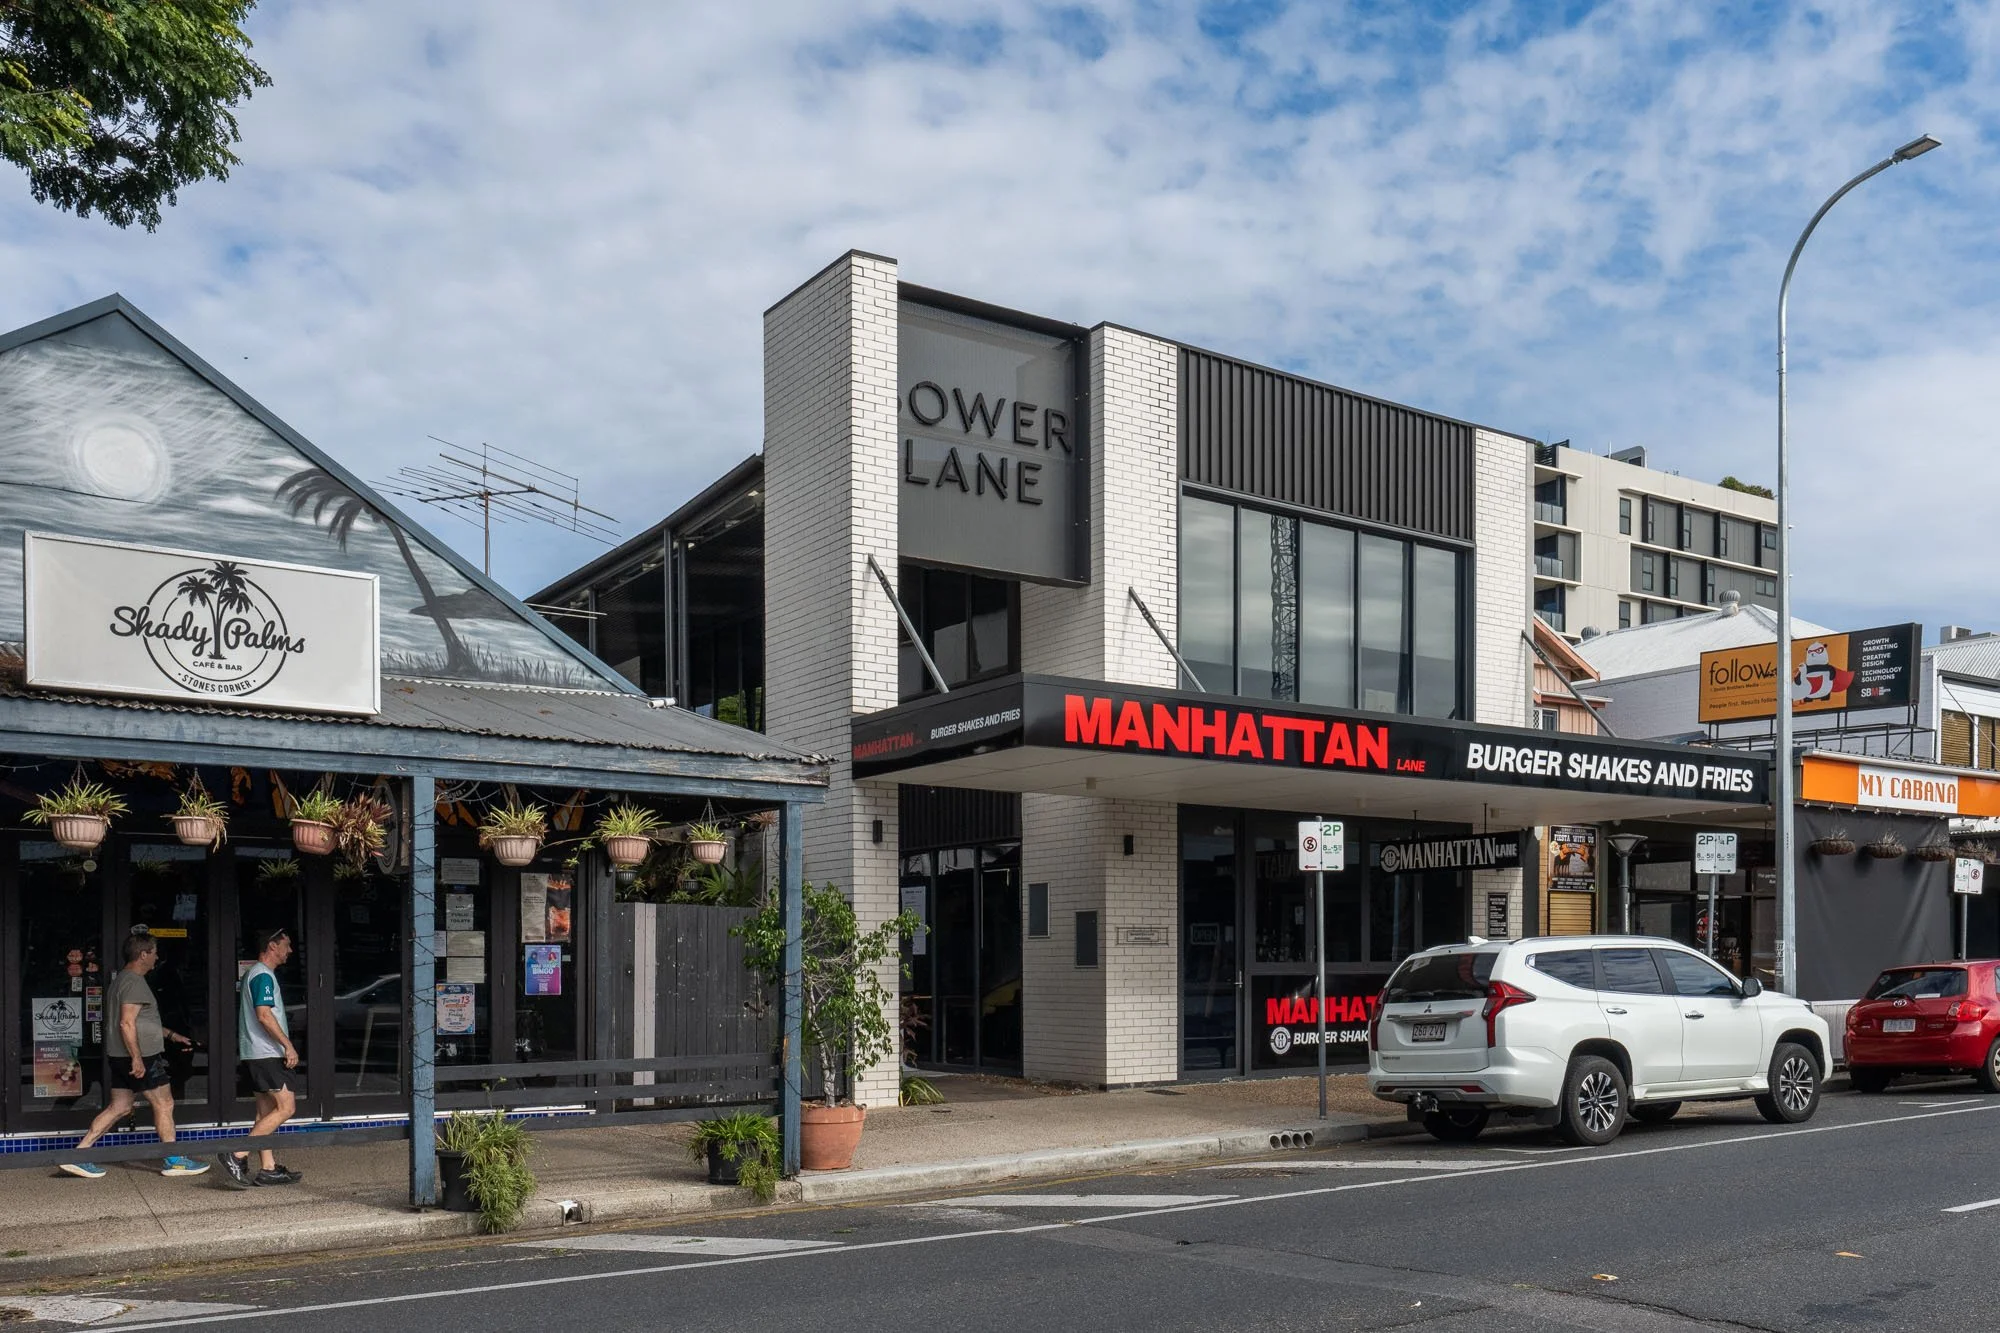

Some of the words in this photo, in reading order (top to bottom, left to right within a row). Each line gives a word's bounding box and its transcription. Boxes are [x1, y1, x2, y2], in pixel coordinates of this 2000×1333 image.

[898, 380, 1072, 454] OWER
[905, 438, 1043, 505] LANE
[110, 605, 211, 657] Shady
[223, 617, 305, 653] Palms
[1862, 637, 1890, 646] GROWTH
[1862, 642, 1898, 652] MARKETING
[1862, 652, 1891, 661] CREATIVE
[192, 660, 215, 669] CAFÉ
[1709, 658, 1771, 686] follow
[1862, 666, 1902, 676] TECHNOLOGY
[181, 674, 216, 693] STONES
[218, 680, 253, 693] CORNER
[1862, 674, 1895, 682] SOLUTIONS
[1861, 687, 1879, 697] SBM
[931, 723, 957, 739] BURGER
[957, 717, 984, 733] SHAKES
[984, 713, 1000, 727] AND
[1001, 708, 1021, 723] FRIES
[1064, 694, 1388, 769] MANHATTAN
[1396, 758, 1426, 773] LANE
[853, 732, 913, 759] MANHATTAN
[1466, 742, 1563, 777] BURGER
[1566, 752, 1652, 784] SHAKES
[1653, 761, 1699, 788] AND
[1701, 766, 1754, 792] FRIES
[1860, 772, 1885, 797] MY
[1890, 777, 1957, 804] CABANA
[1323, 824, 1342, 836] 2P
[1554, 834, 1571, 842] FIESTA
[1573, 835, 1586, 843] WITH
[1698, 835, 1714, 845] 2P
[1400, 837, 1496, 870] MANHATTAN
[1495, 843, 1517, 857] LANE
[532, 967, 553, 975] BINGO
[461, 995, 470, 1004] 13
[35, 1011, 57, 1024] Shady
